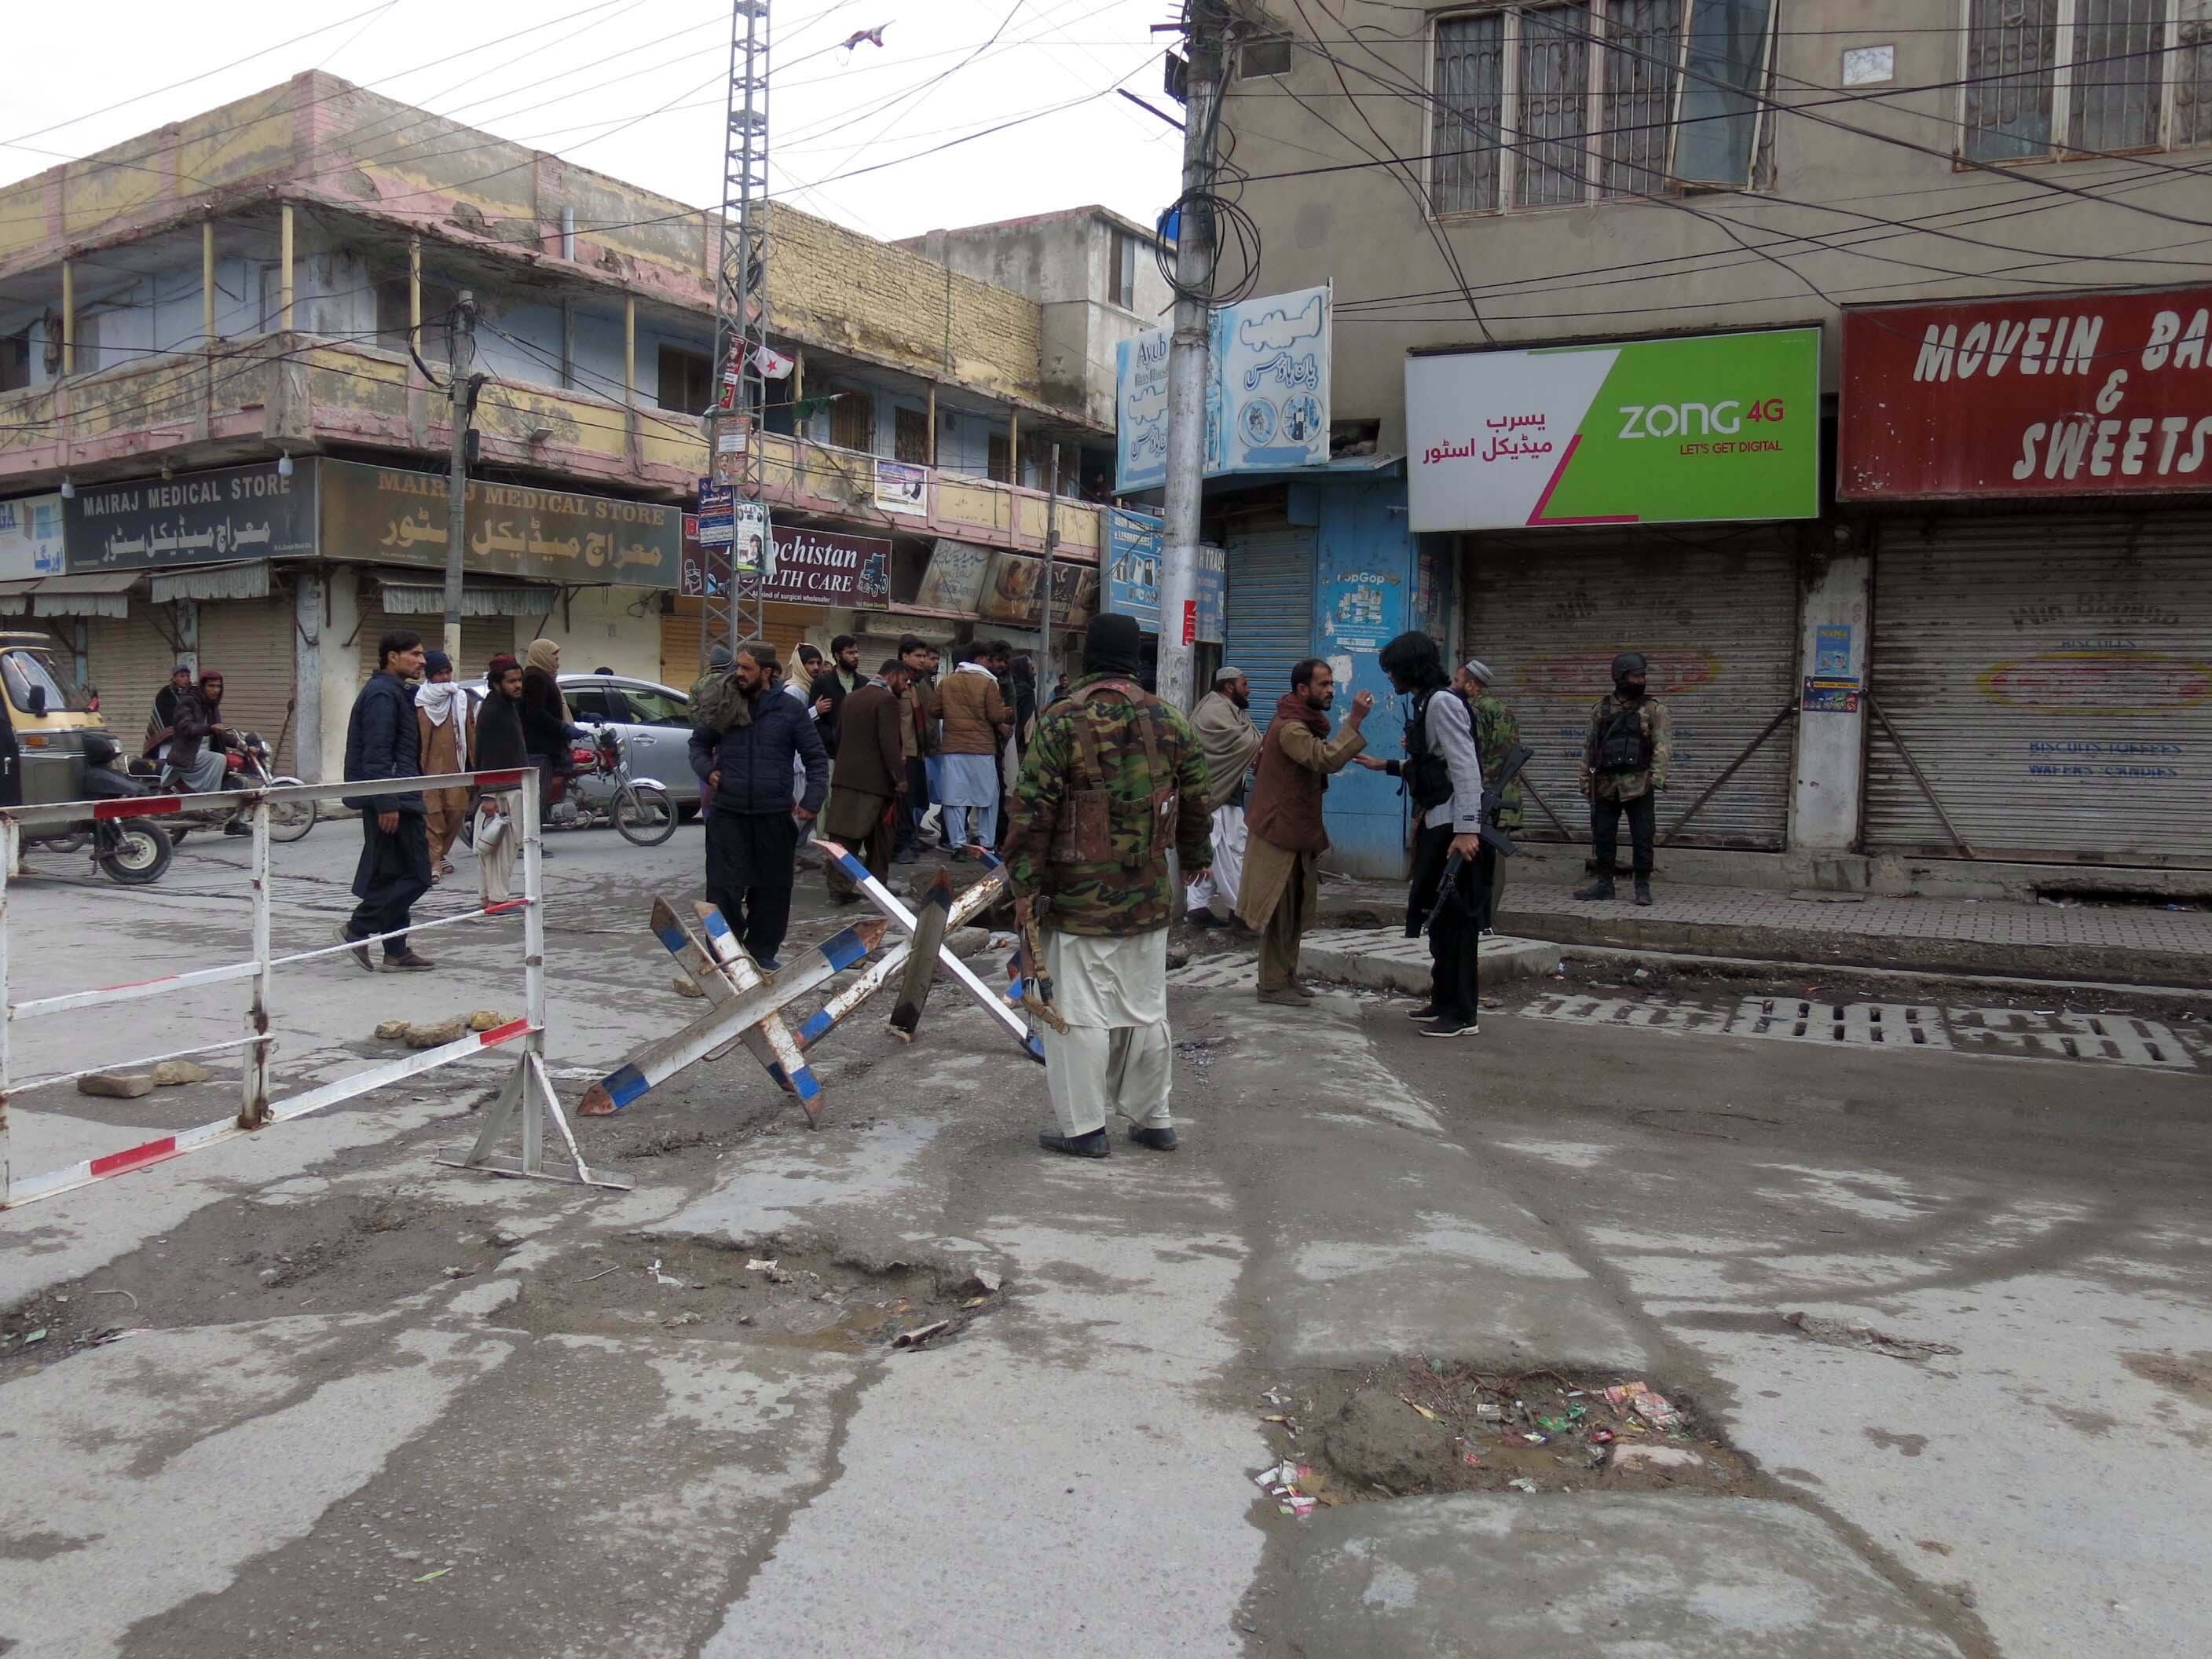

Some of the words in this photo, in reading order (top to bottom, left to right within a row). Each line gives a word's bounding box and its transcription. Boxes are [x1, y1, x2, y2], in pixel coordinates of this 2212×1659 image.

[1136, 331, 1168, 368] Ayub
[1913, 316, 2104, 382] MOVEIN
[2141, 308, 2212, 371] BA
[1293, 353, 1317, 390] پان
[1746, 397, 1785, 423] 4G
[2095, 368, 2129, 414] &
[1423, 438, 1475, 464] اسٹور
[1482, 434, 1554, 462] میڈیکل
[1679, 442, 1710, 456] LET'S
[1712, 441, 1736, 454] GET
[1738, 439, 1783, 453] DIGITAL
[2012, 416, 2212, 480] SWEETS
[83, 490, 139, 515] MAIRAJ
[148, 480, 222, 509] MEDICAL
[230, 474, 291, 500] STORE
[378, 471, 477, 504] MAIRJ
[485, 487, 589, 516] MEDICAL
[595, 503, 665, 526] STORE
[145, 514, 214, 558] میڈیکل
[217, 515, 271, 553] معراج
[471, 515, 581, 562] میڈیکل
[808, 572, 854, 592] CARE
